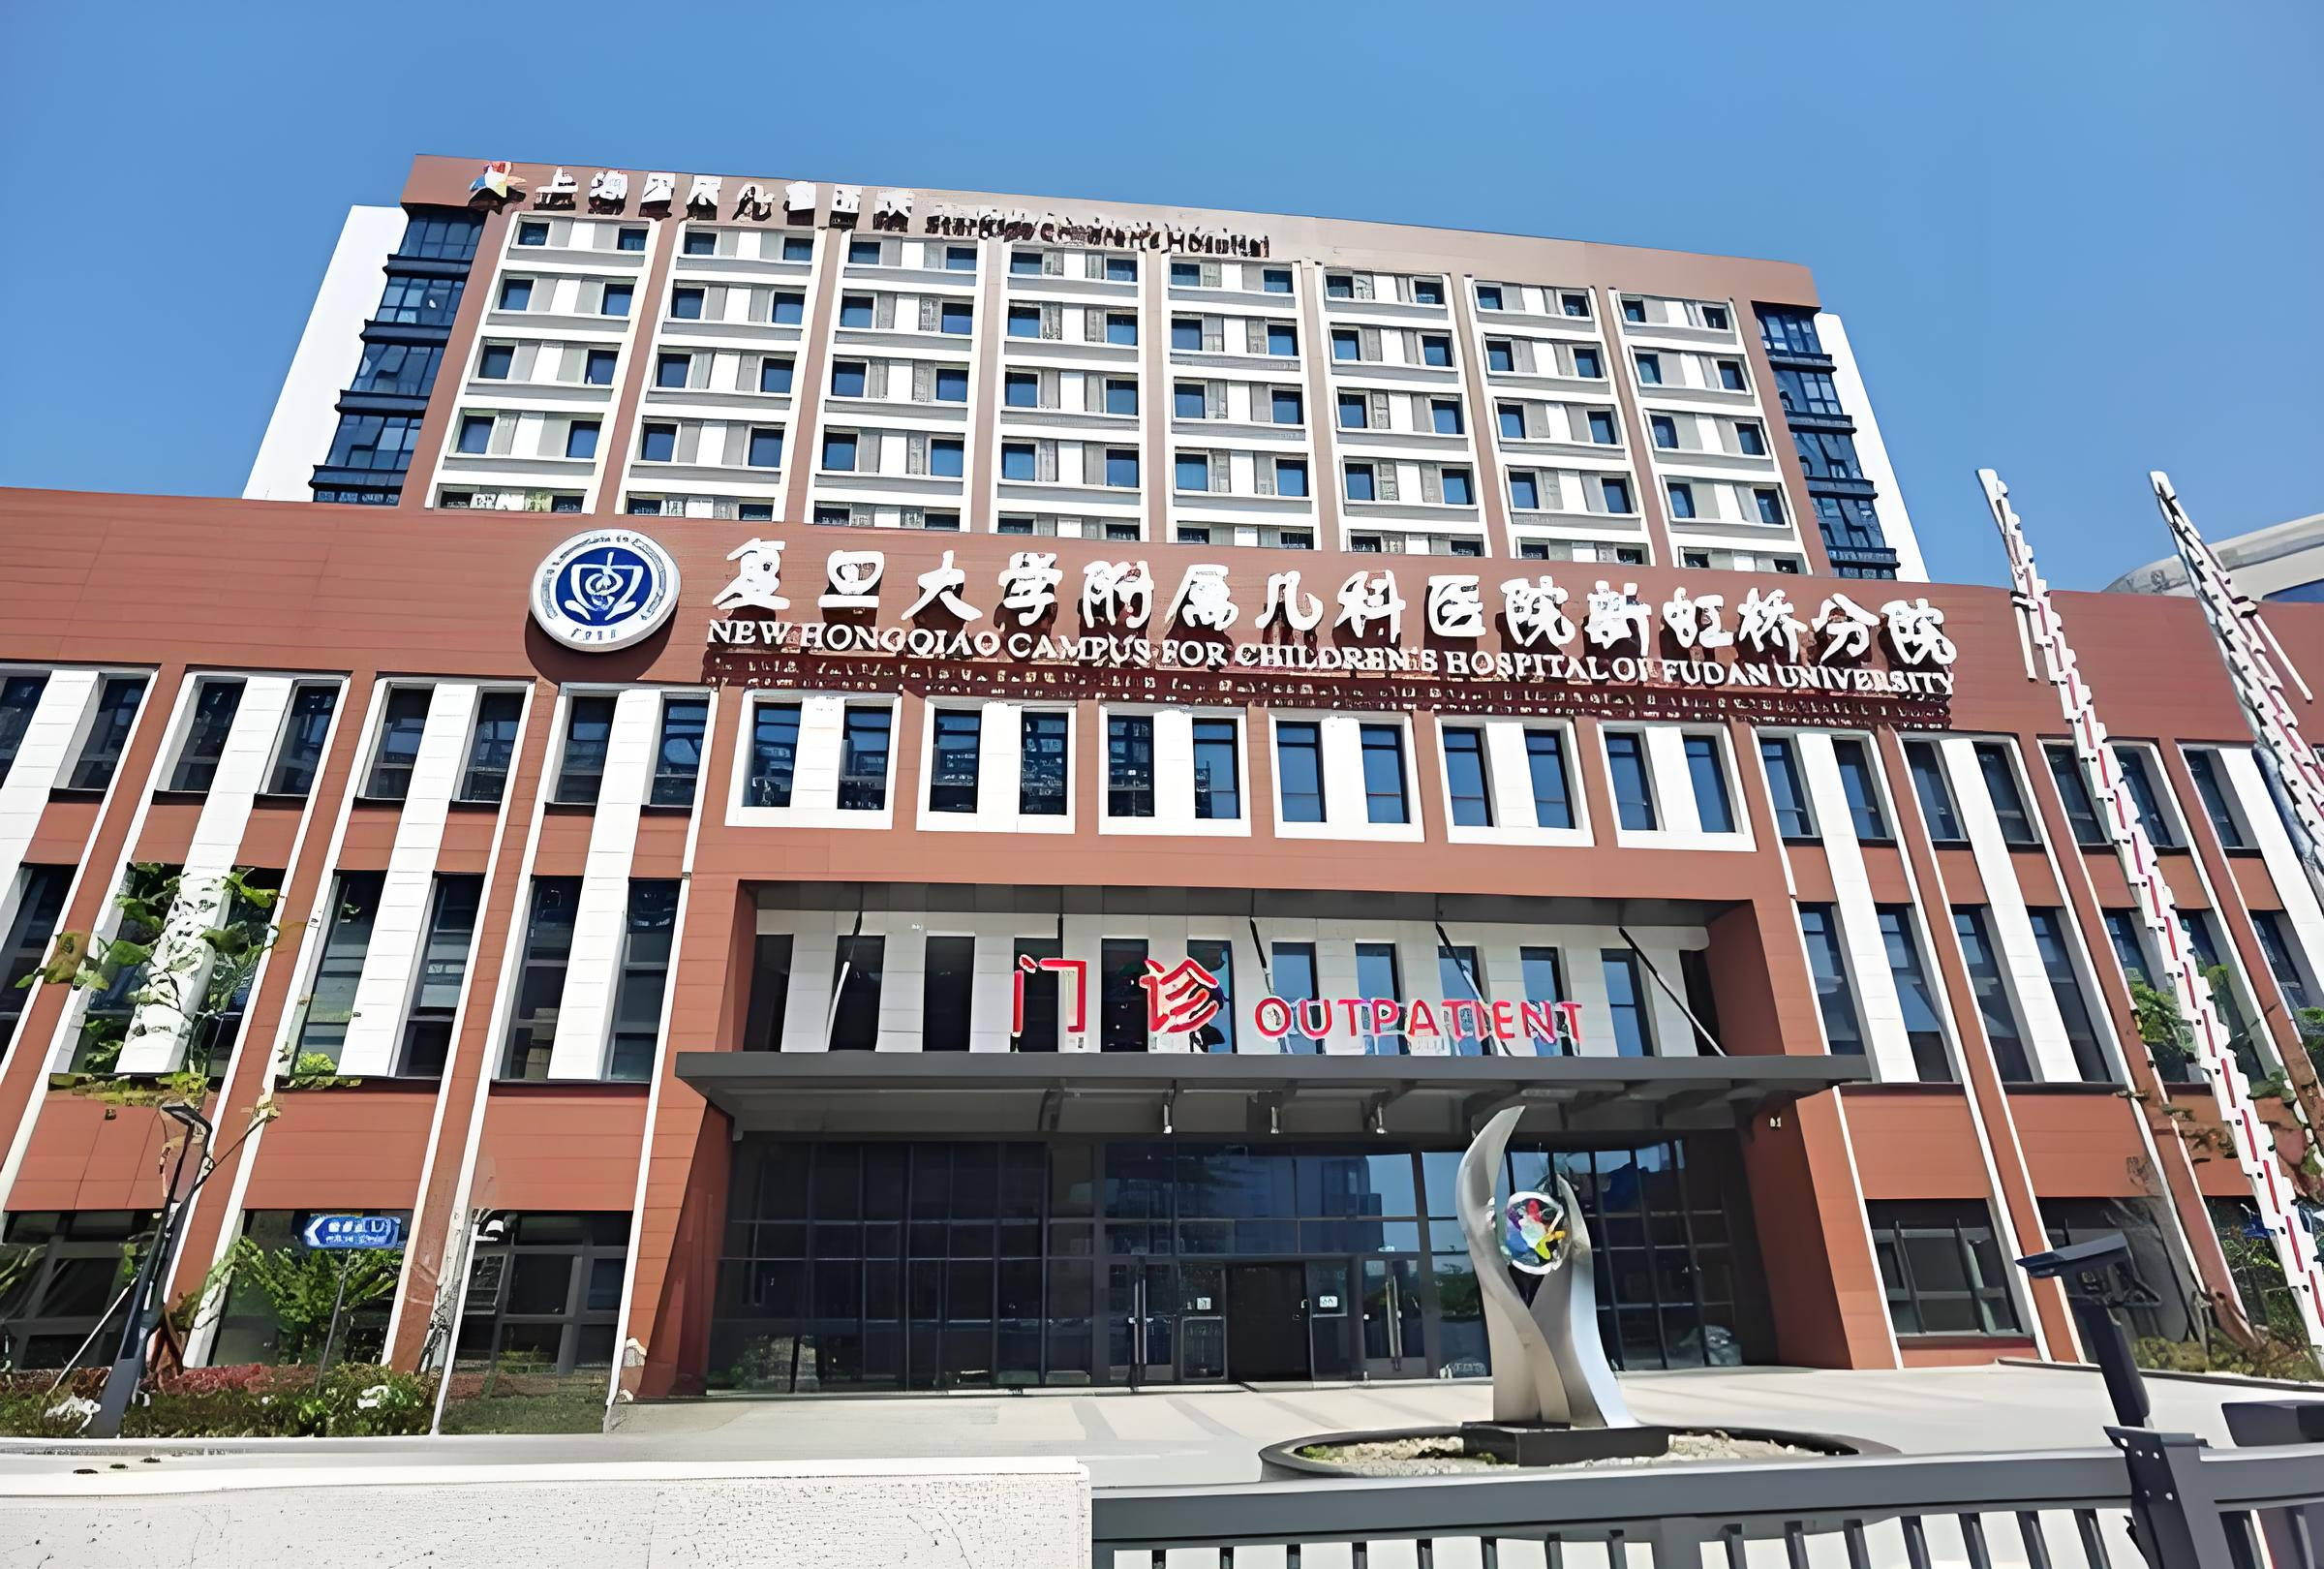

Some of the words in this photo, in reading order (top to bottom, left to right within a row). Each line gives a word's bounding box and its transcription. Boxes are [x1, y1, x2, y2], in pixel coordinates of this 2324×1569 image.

[712, 538, 1958, 665] 复旦大学附属儿科医院新虹桥分院
[707, 620, 792, 646] NEW
[1007, 631, 1151, 667] CAMPUS
[1161, 638, 1229, 668] FOR
[1662, 660, 1769, 687] FUDAN
[1773, 661, 1954, 695] UNIVERSITY
[1011, 954, 1219, 1037] 门诊
[1255, 995, 1583, 1044] OUTPATIENT
